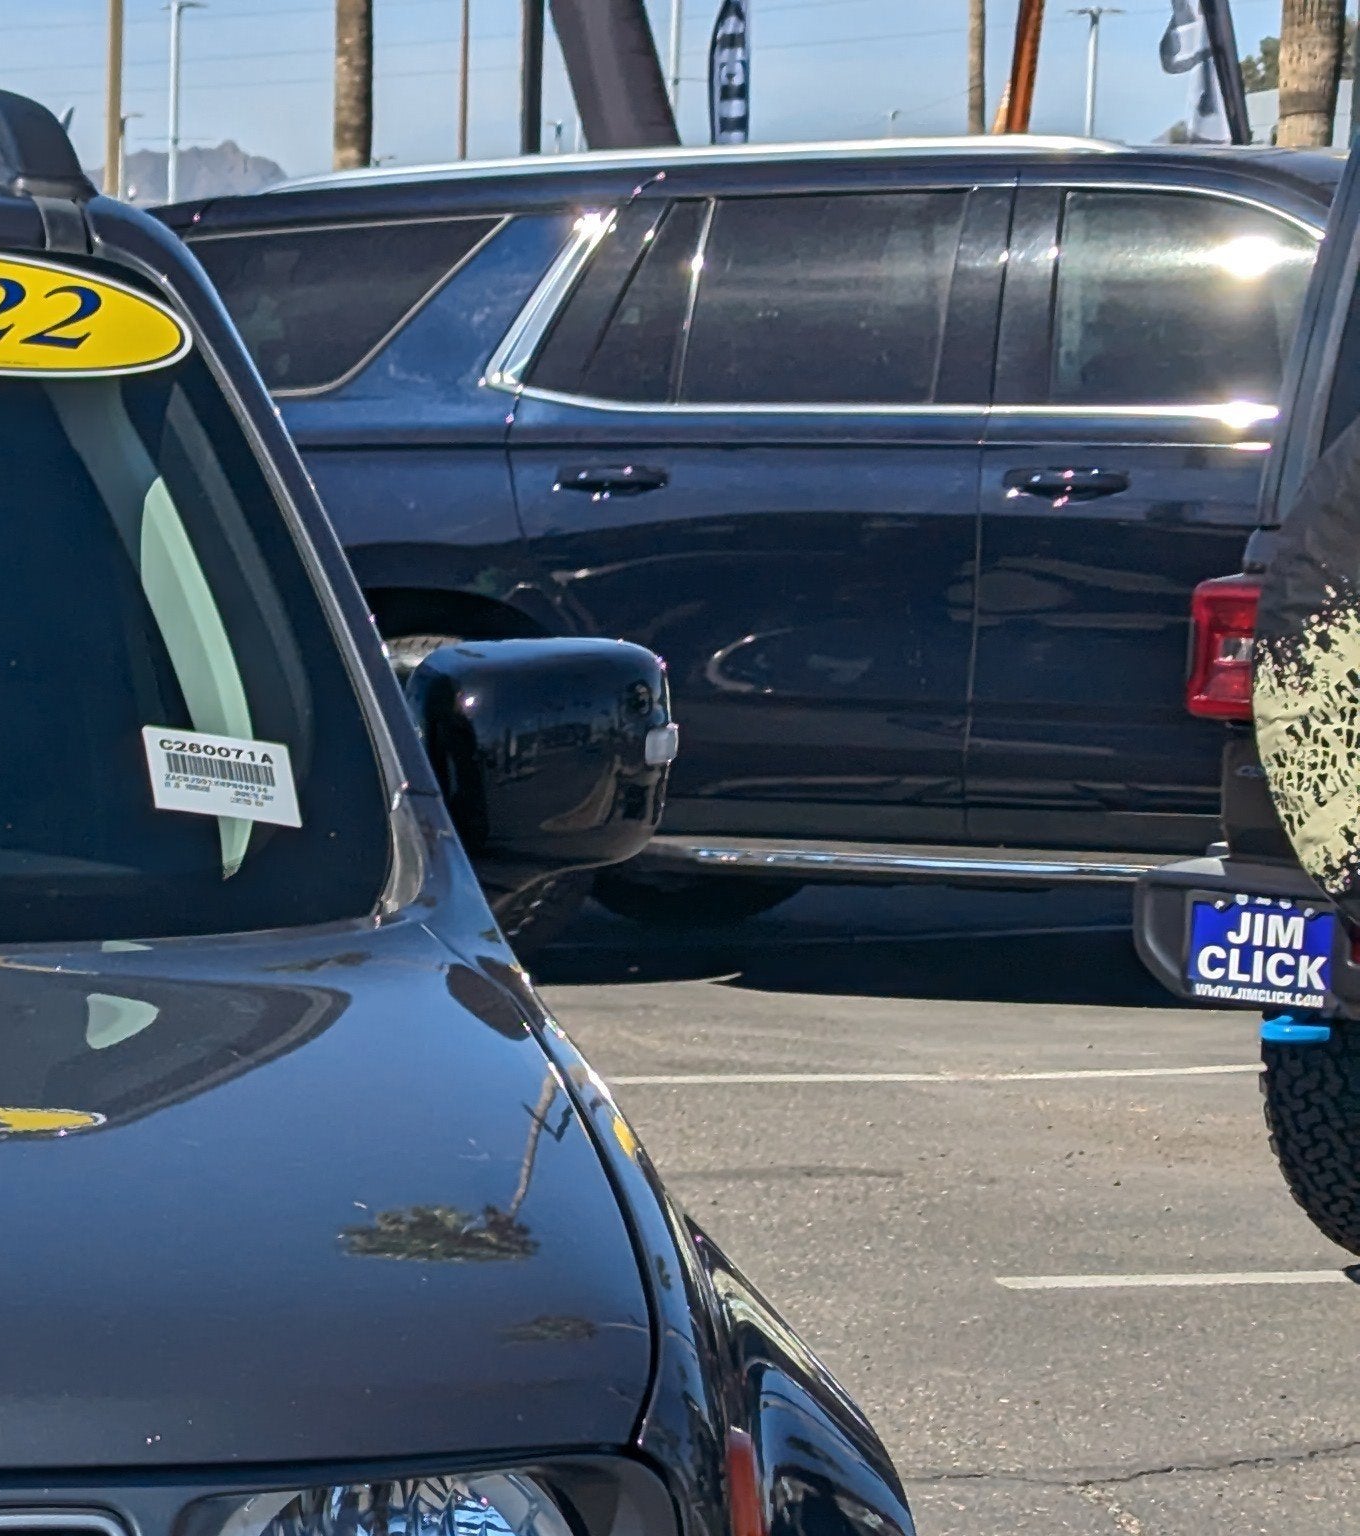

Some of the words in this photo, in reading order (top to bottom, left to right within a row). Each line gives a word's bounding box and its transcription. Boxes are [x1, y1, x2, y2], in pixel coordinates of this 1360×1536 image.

[1227, 911, 1306, 950] JIM
[1197, 945, 1328, 990] CLICK
[1194, 983, 1324, 1008] WWW.JIMCLICK.COM
